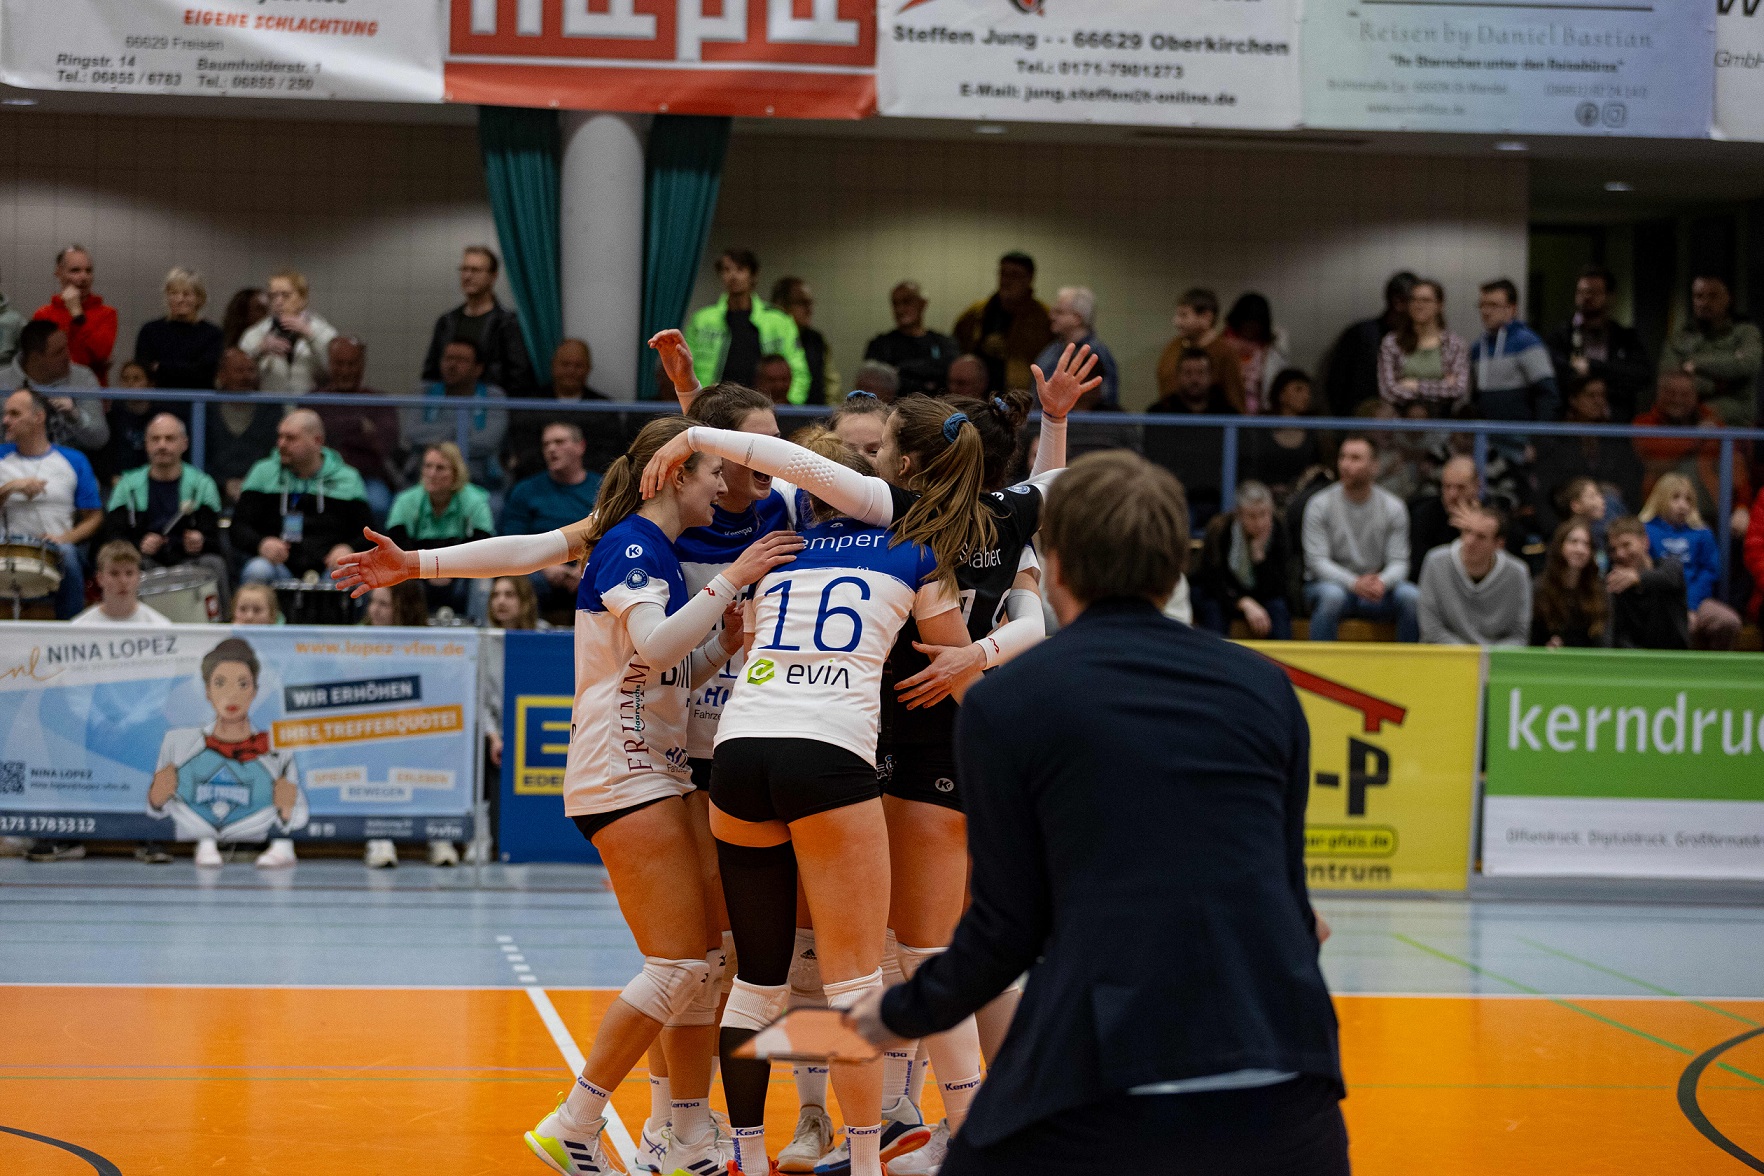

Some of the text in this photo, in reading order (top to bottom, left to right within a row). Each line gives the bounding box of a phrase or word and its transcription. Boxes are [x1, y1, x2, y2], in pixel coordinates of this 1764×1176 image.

[184, 9, 379, 37] EIGENE SCHLACHTUNG
[1360, 20, 1652, 50] Reisen by Daniel Bastian
[894, 25, 975, 45] Steffen
[981, 29, 1038, 50] Jung
[1073, 30, 1143, 49] 66629
[1151, 33, 1289, 55] Oberkirchen
[56, 53, 136, 69] Ringstr. 14
[803, 534, 884, 552] emper
[757, 576, 870, 653] 16
[47, 641, 103, 664] NINA
[108, 636, 179, 659] LOPEZ
[293, 680, 413, 707] WIR ERHÖHEN
[280, 711, 457, 744] IHRE TREFFERQUOTE!
[1508, 688, 1764, 755] kerndru
[524, 776, 566, 785] EDE
[884, 1051, 907, 1059] mpa
[737, 1127, 764, 1137] Kemp
[849, 1126, 881, 1136] Kemp
